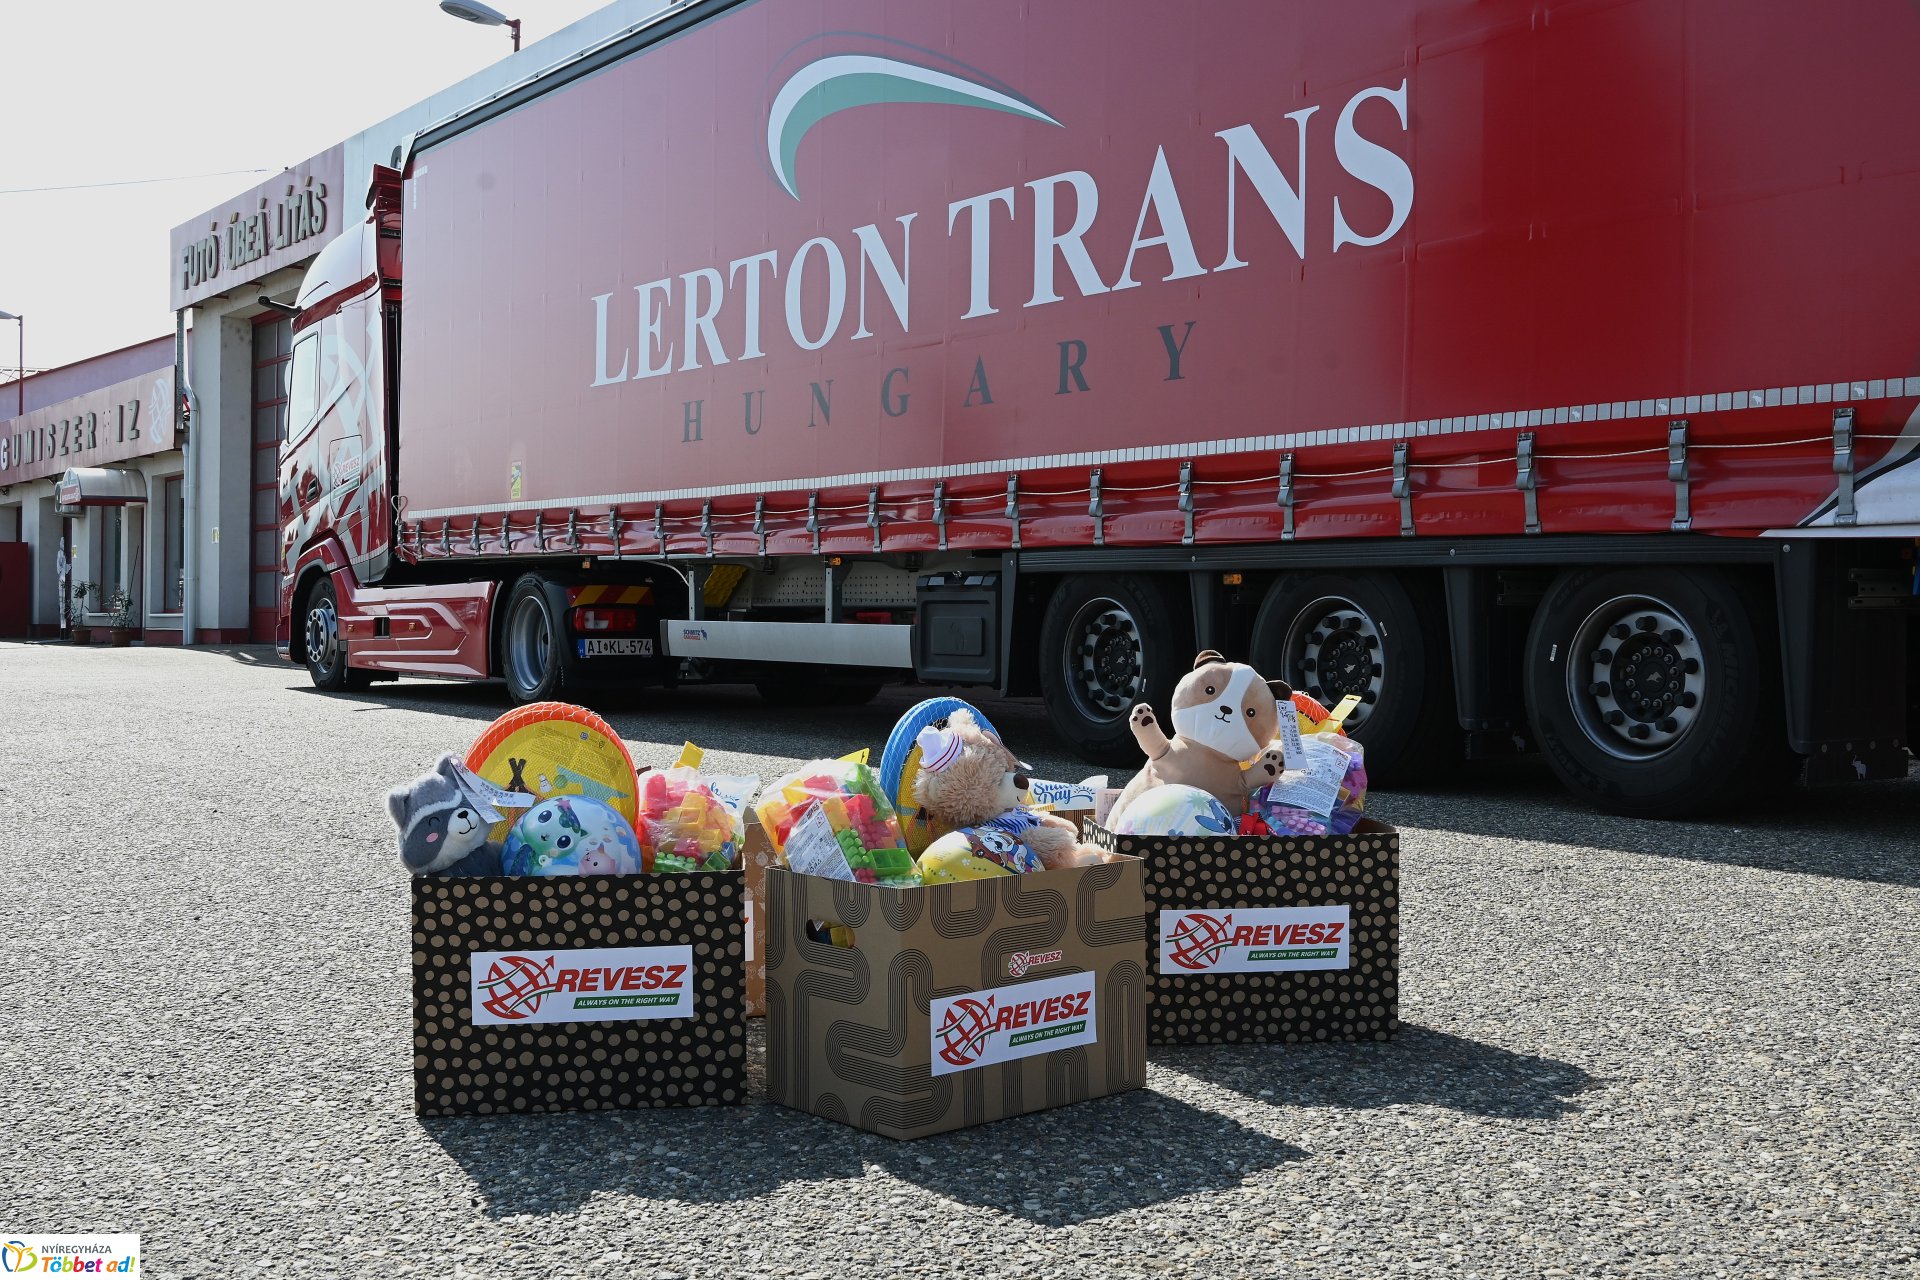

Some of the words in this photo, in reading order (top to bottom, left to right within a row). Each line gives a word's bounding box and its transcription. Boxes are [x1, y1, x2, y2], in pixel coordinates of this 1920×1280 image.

[590, 212, 918, 387] LERTON
[948, 78, 1414, 320] TRANS
[681, 321, 1196, 443] HUNGARY
[1038, 789, 1071, 804] Day
[1231, 922, 1345, 947] REVESZ
[1028, 951, 1062, 965] REVESZ
[555, 964, 688, 993] REVESZ
[577, 998, 607, 1007] ALWAYS
[620, 997, 634, 1005] THE
[634, 996, 658, 1004] RIGHT
[994, 991, 1092, 1032] REVESZ
[1012, 1034, 1034, 1044] ALWAYS
[1034, 1031, 1043, 1039] ON
[1043, 1029, 1054, 1038] THE
[1054, 1026, 1071, 1036] RIGHT
[1071, 1023, 1084, 1032] WAY
